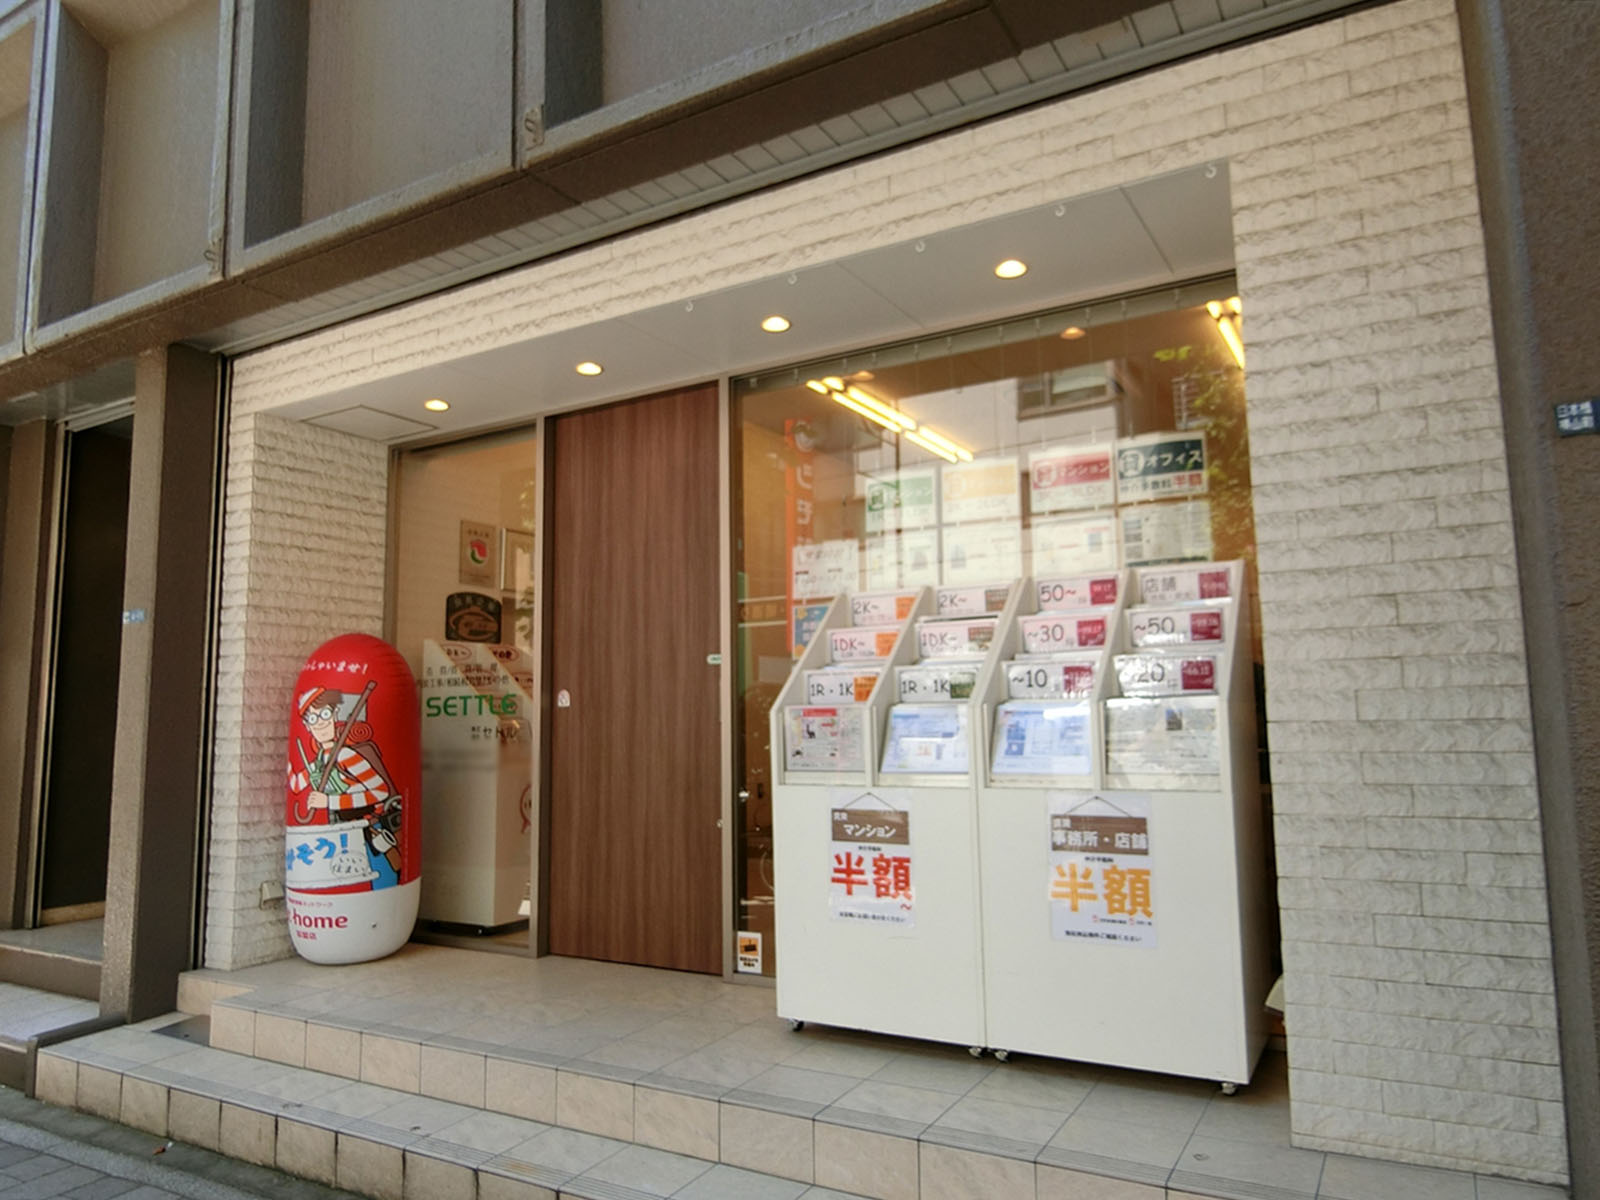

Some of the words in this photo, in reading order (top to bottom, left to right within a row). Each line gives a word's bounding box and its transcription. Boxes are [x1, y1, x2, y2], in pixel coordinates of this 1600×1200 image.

[1145, 450, 1202, 467] オフィス
[426, 693, 518, 718] SETTLE
[843, 823, 896, 838] マンション
[1052, 830, 1148, 849] 事務所・店舗
[831, 851, 912, 901] 半額
[1051, 863, 1153, 918] 半額
[293, 907, 348, 929] home
